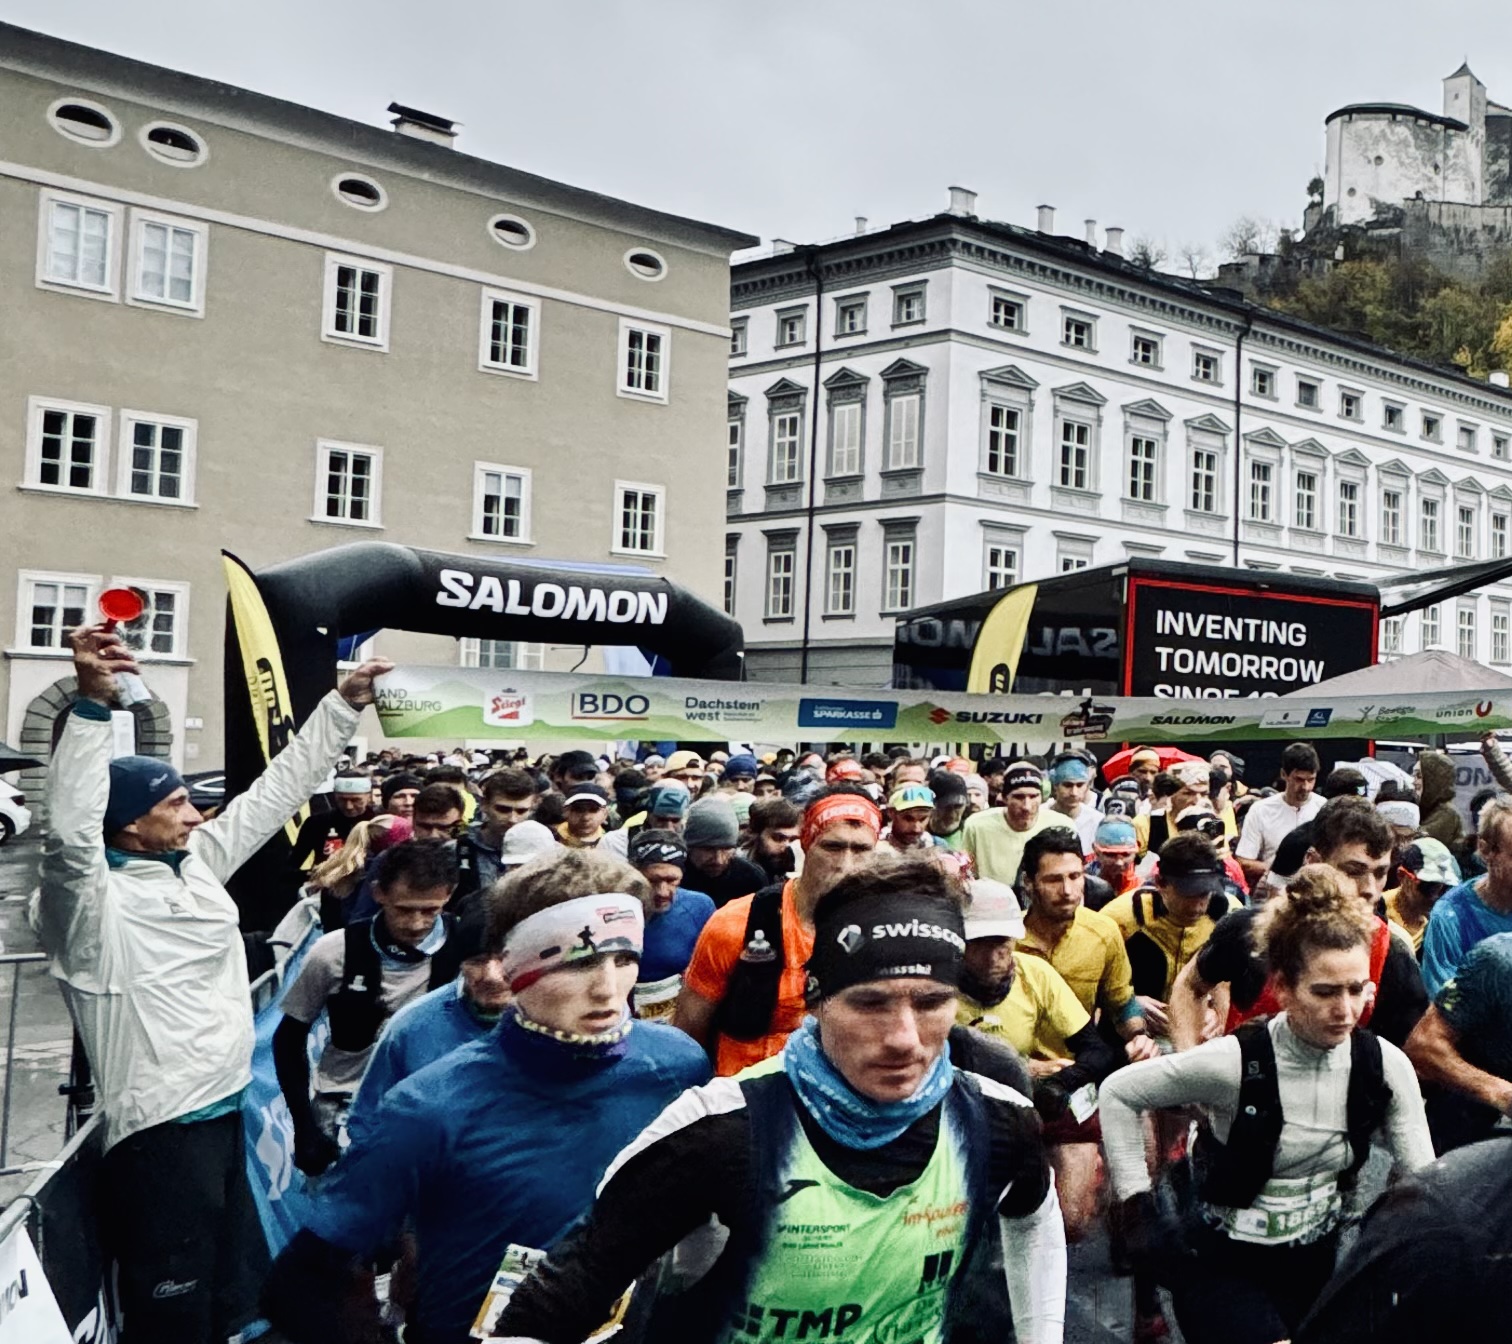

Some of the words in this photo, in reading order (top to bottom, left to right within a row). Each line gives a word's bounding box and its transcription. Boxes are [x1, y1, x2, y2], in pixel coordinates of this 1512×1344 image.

[436, 569, 668, 625] SALOMON
[1156, 609, 1307, 646] INVENTING
[1154, 646, 1325, 684] TOMORROW
[580, 693, 650, 715] BDO
[685, 696, 760, 711] Dachstein
[685, 712, 720, 722] west
[813, 709, 871, 720] SPARKASSE
[955, 710, 1043, 725] SUZUKI
[1149, 715, 1237, 725] SALOMON
[1436, 709, 1473, 718] union
[872, 919, 966, 955] swissco
[769, 1303, 862, 1339] TMP
